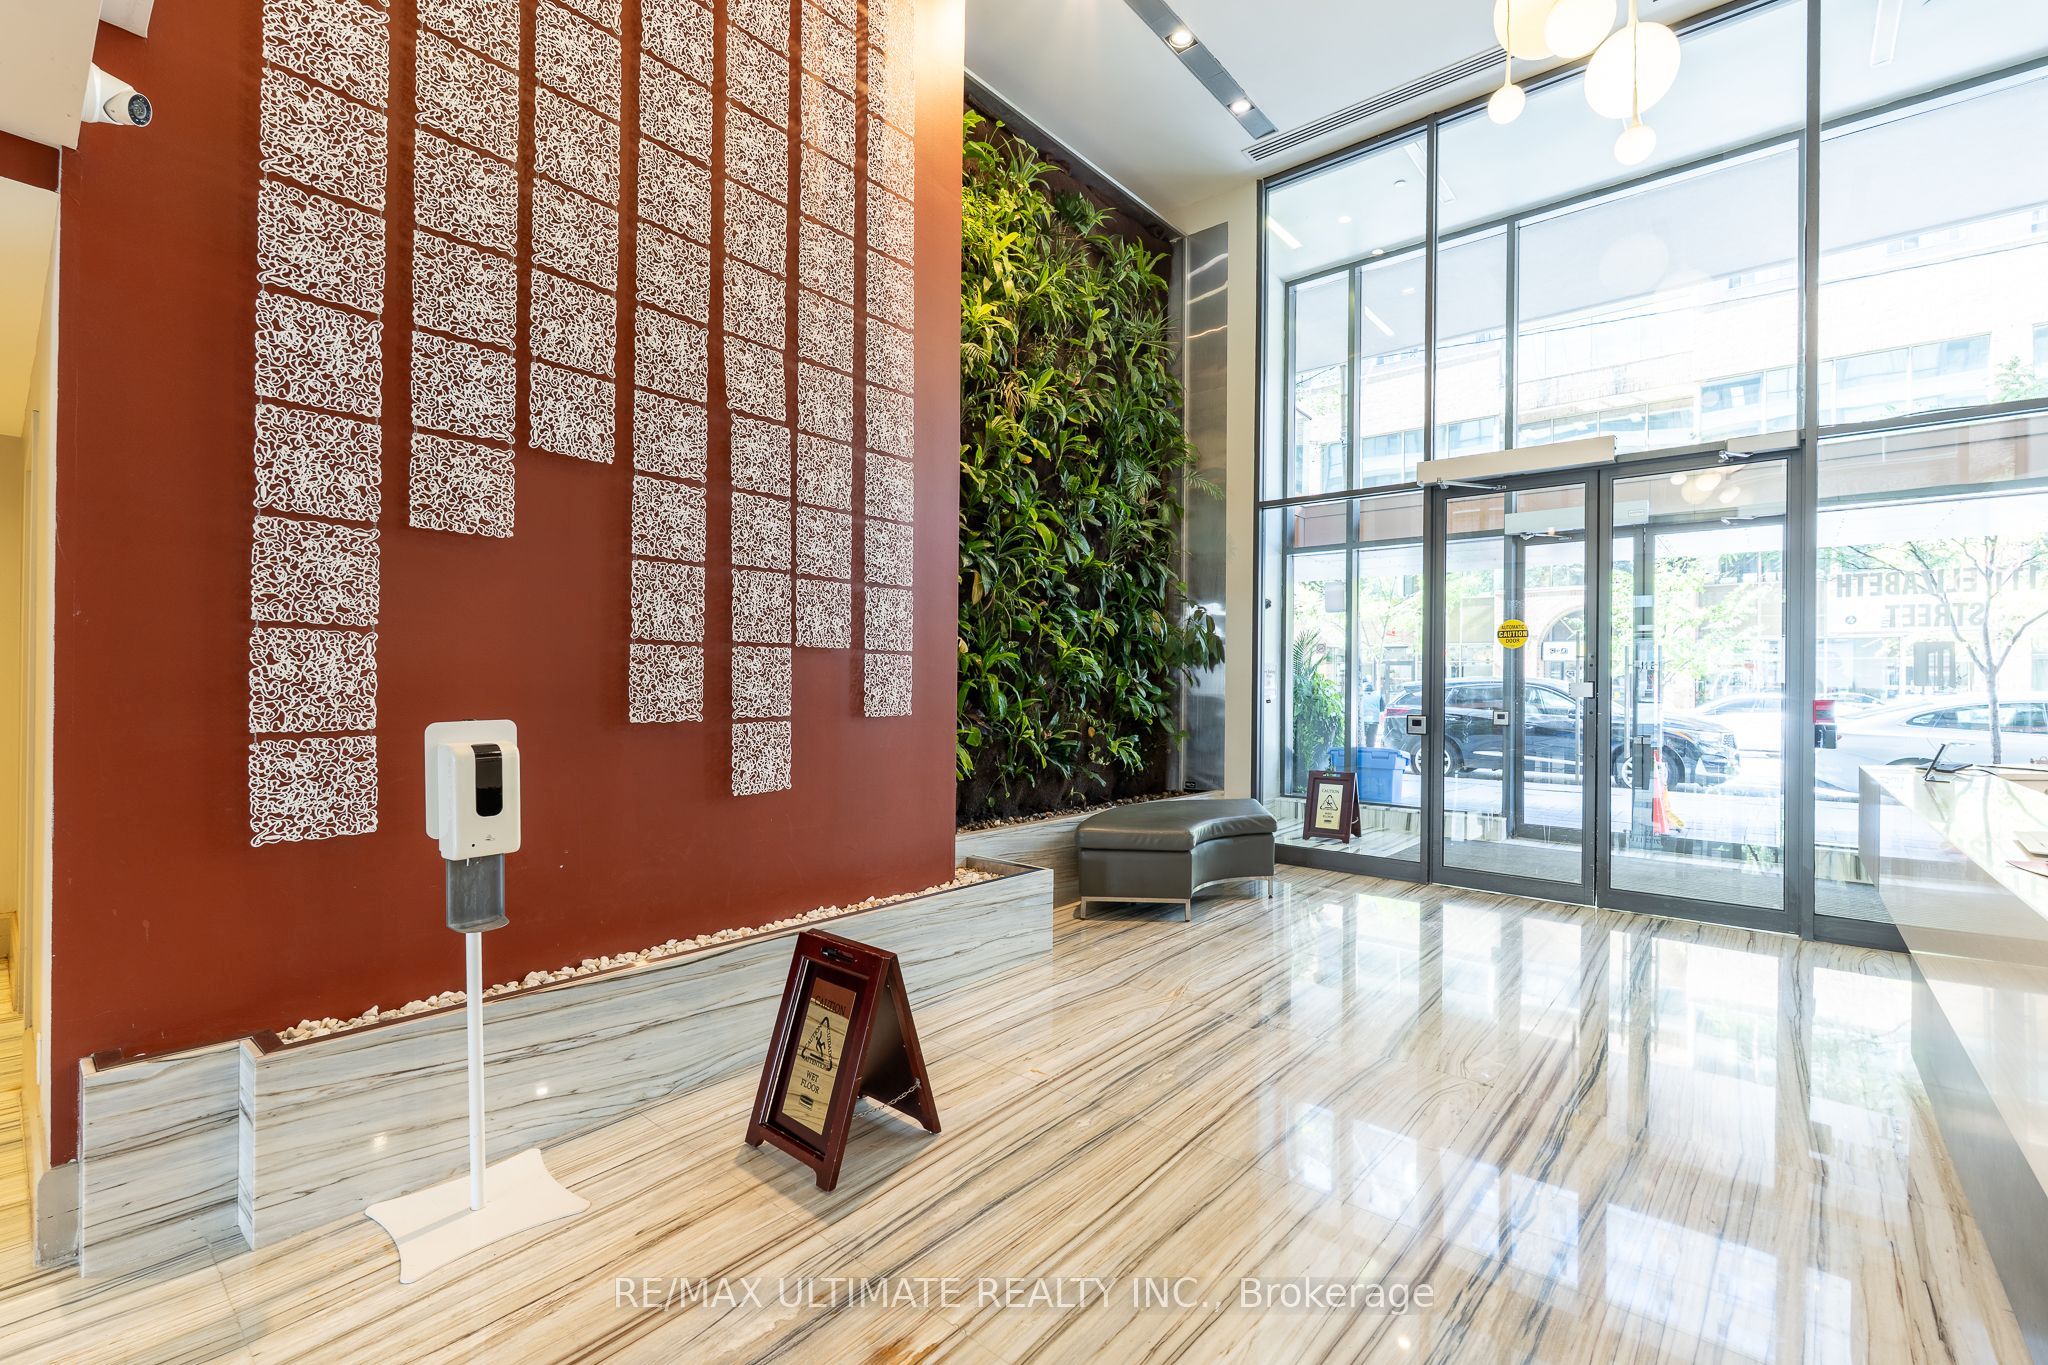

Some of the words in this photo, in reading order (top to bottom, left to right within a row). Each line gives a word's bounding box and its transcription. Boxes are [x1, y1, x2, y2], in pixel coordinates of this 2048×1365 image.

[1498, 630, 1528, 638] CAUTION
[814, 995, 846, 1017] CAUTION
[806, 1070, 819, 1081] WET
[800, 1078, 820, 1094] FLOOR
